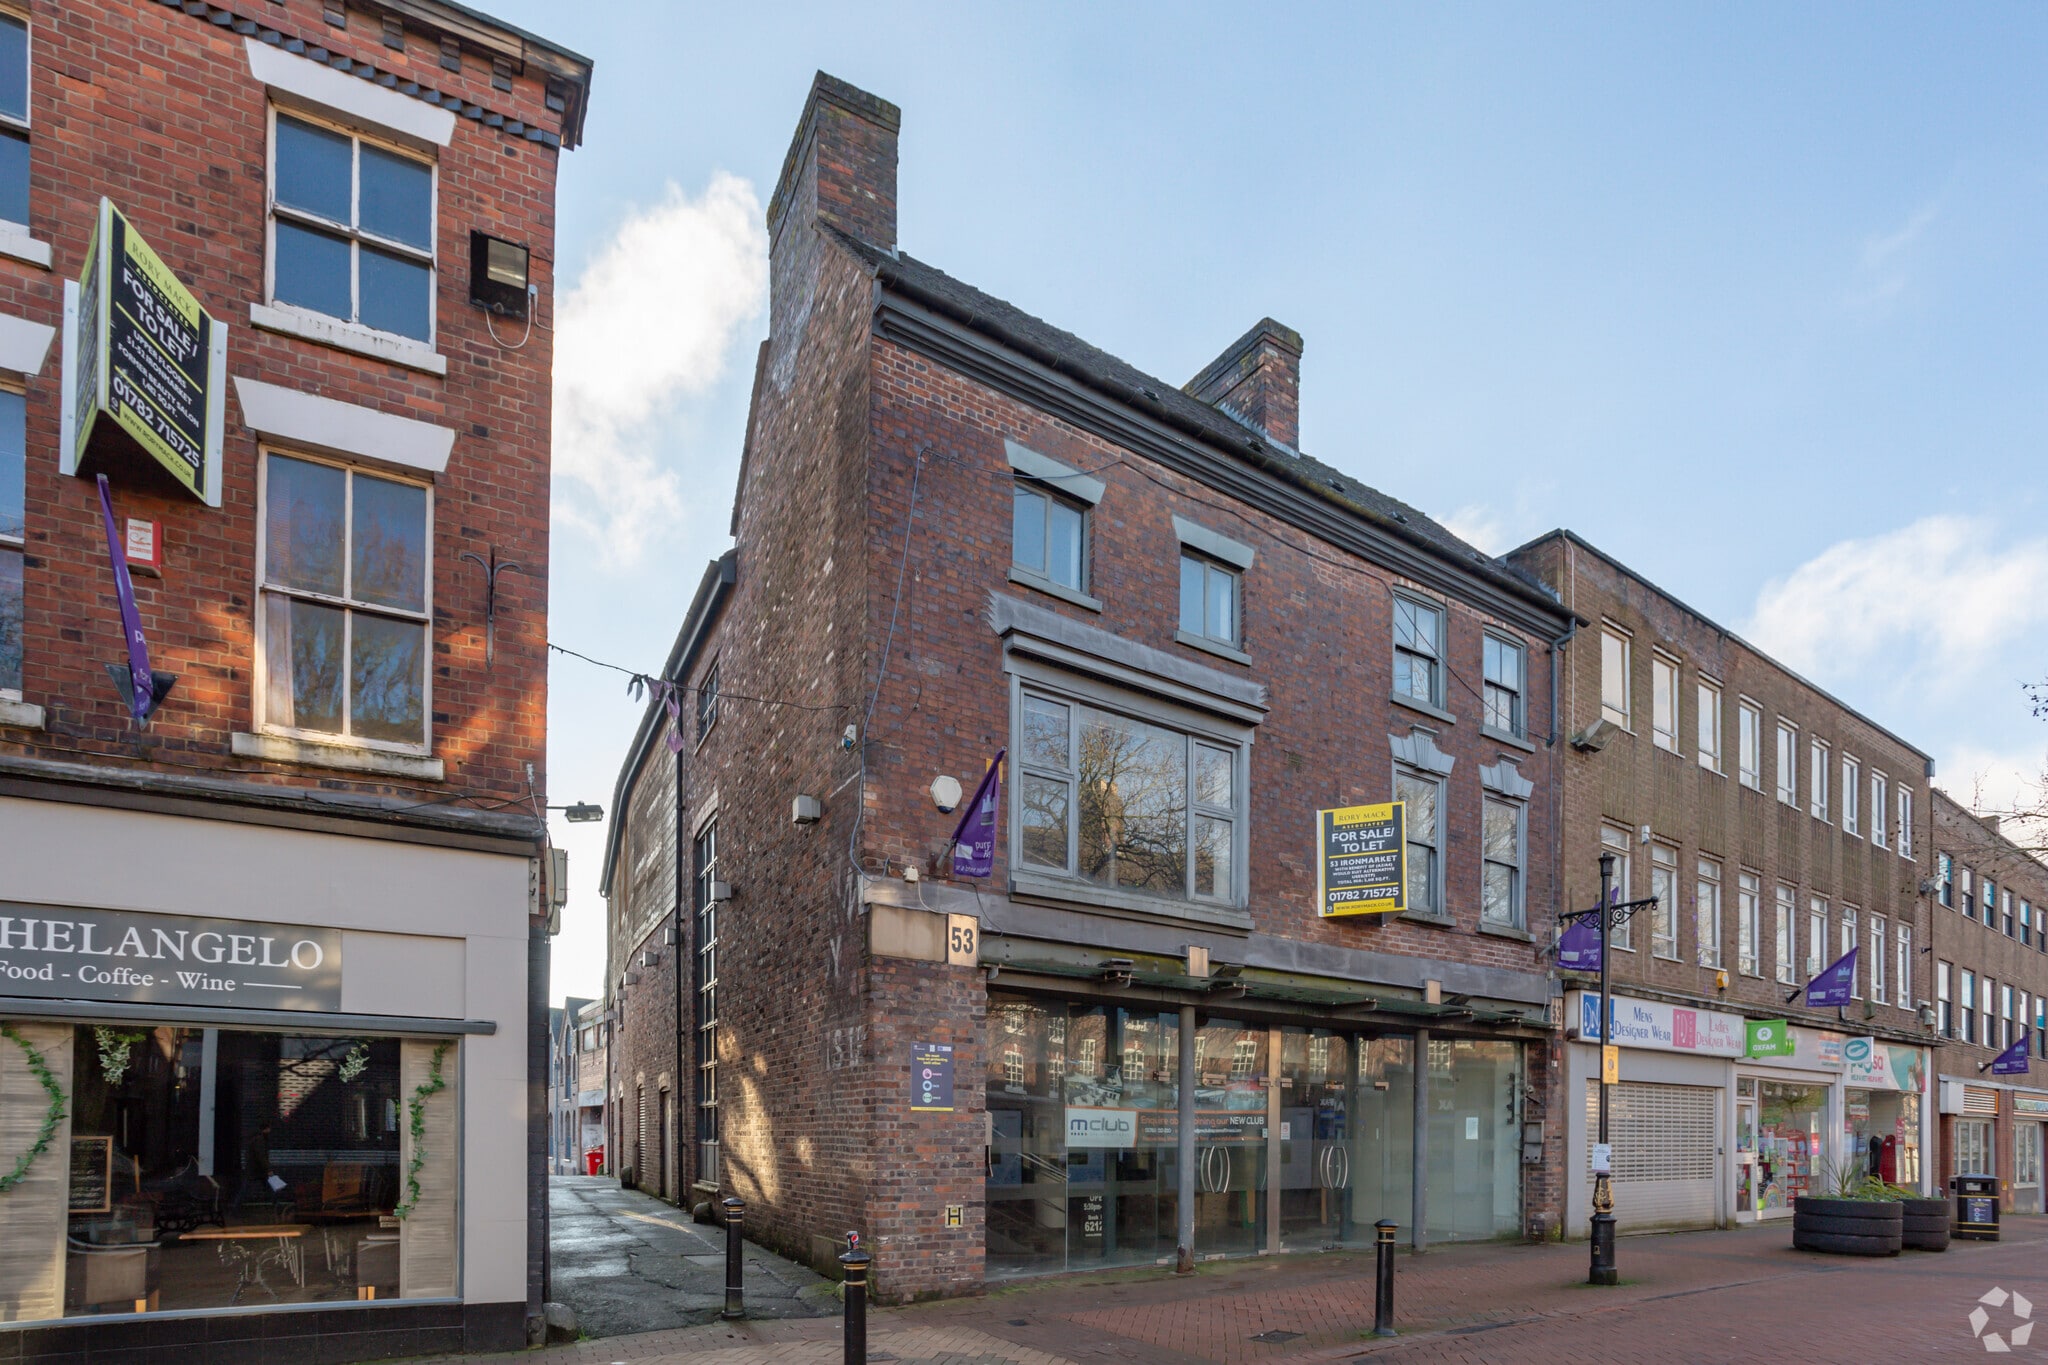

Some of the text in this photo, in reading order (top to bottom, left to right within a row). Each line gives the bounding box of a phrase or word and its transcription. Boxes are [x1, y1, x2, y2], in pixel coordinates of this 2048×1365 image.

[133, 241, 192, 317] RORY MACK
[124, 267, 154, 314] FOR
[156, 302, 191, 353] SALE
[136, 265, 189, 330] ASSOCIATES
[136, 300, 186, 367] TO LET
[134, 329, 187, 390] UPPER FLOORS
[118, 341, 199, 429] FORMER BEAUTY SALON
[146, 354, 192, 407] IRONMARKET
[114, 374, 199, 469] 01782 715725
[1364, 811, 1386, 819] MACK
[1332, 827, 1395, 843] FOR SALE/
[1342, 840, 1385, 853] TO LET
[1341, 855, 1397, 866] IRONMARKET
[1329, 887, 1399, 902] 01782 715725
[0, 916, 323, 970] HELANGELO
[951, 927, 974, 954] 53
[0, 960, 54, 981] Food
[78, 965, 154, 987] Coffee
[176, 971, 236, 991] Wine
[1753, 1043, 1776, 1051] OXFAM
[1141, 1115, 1168, 1126] Enquire
[1194, 1116, 1216, 1128] oining
[1230, 1116, 1245, 1125] NEW
[1246, 1116, 1264, 1125] CLUB
[948, 1208, 961, 1225] H
